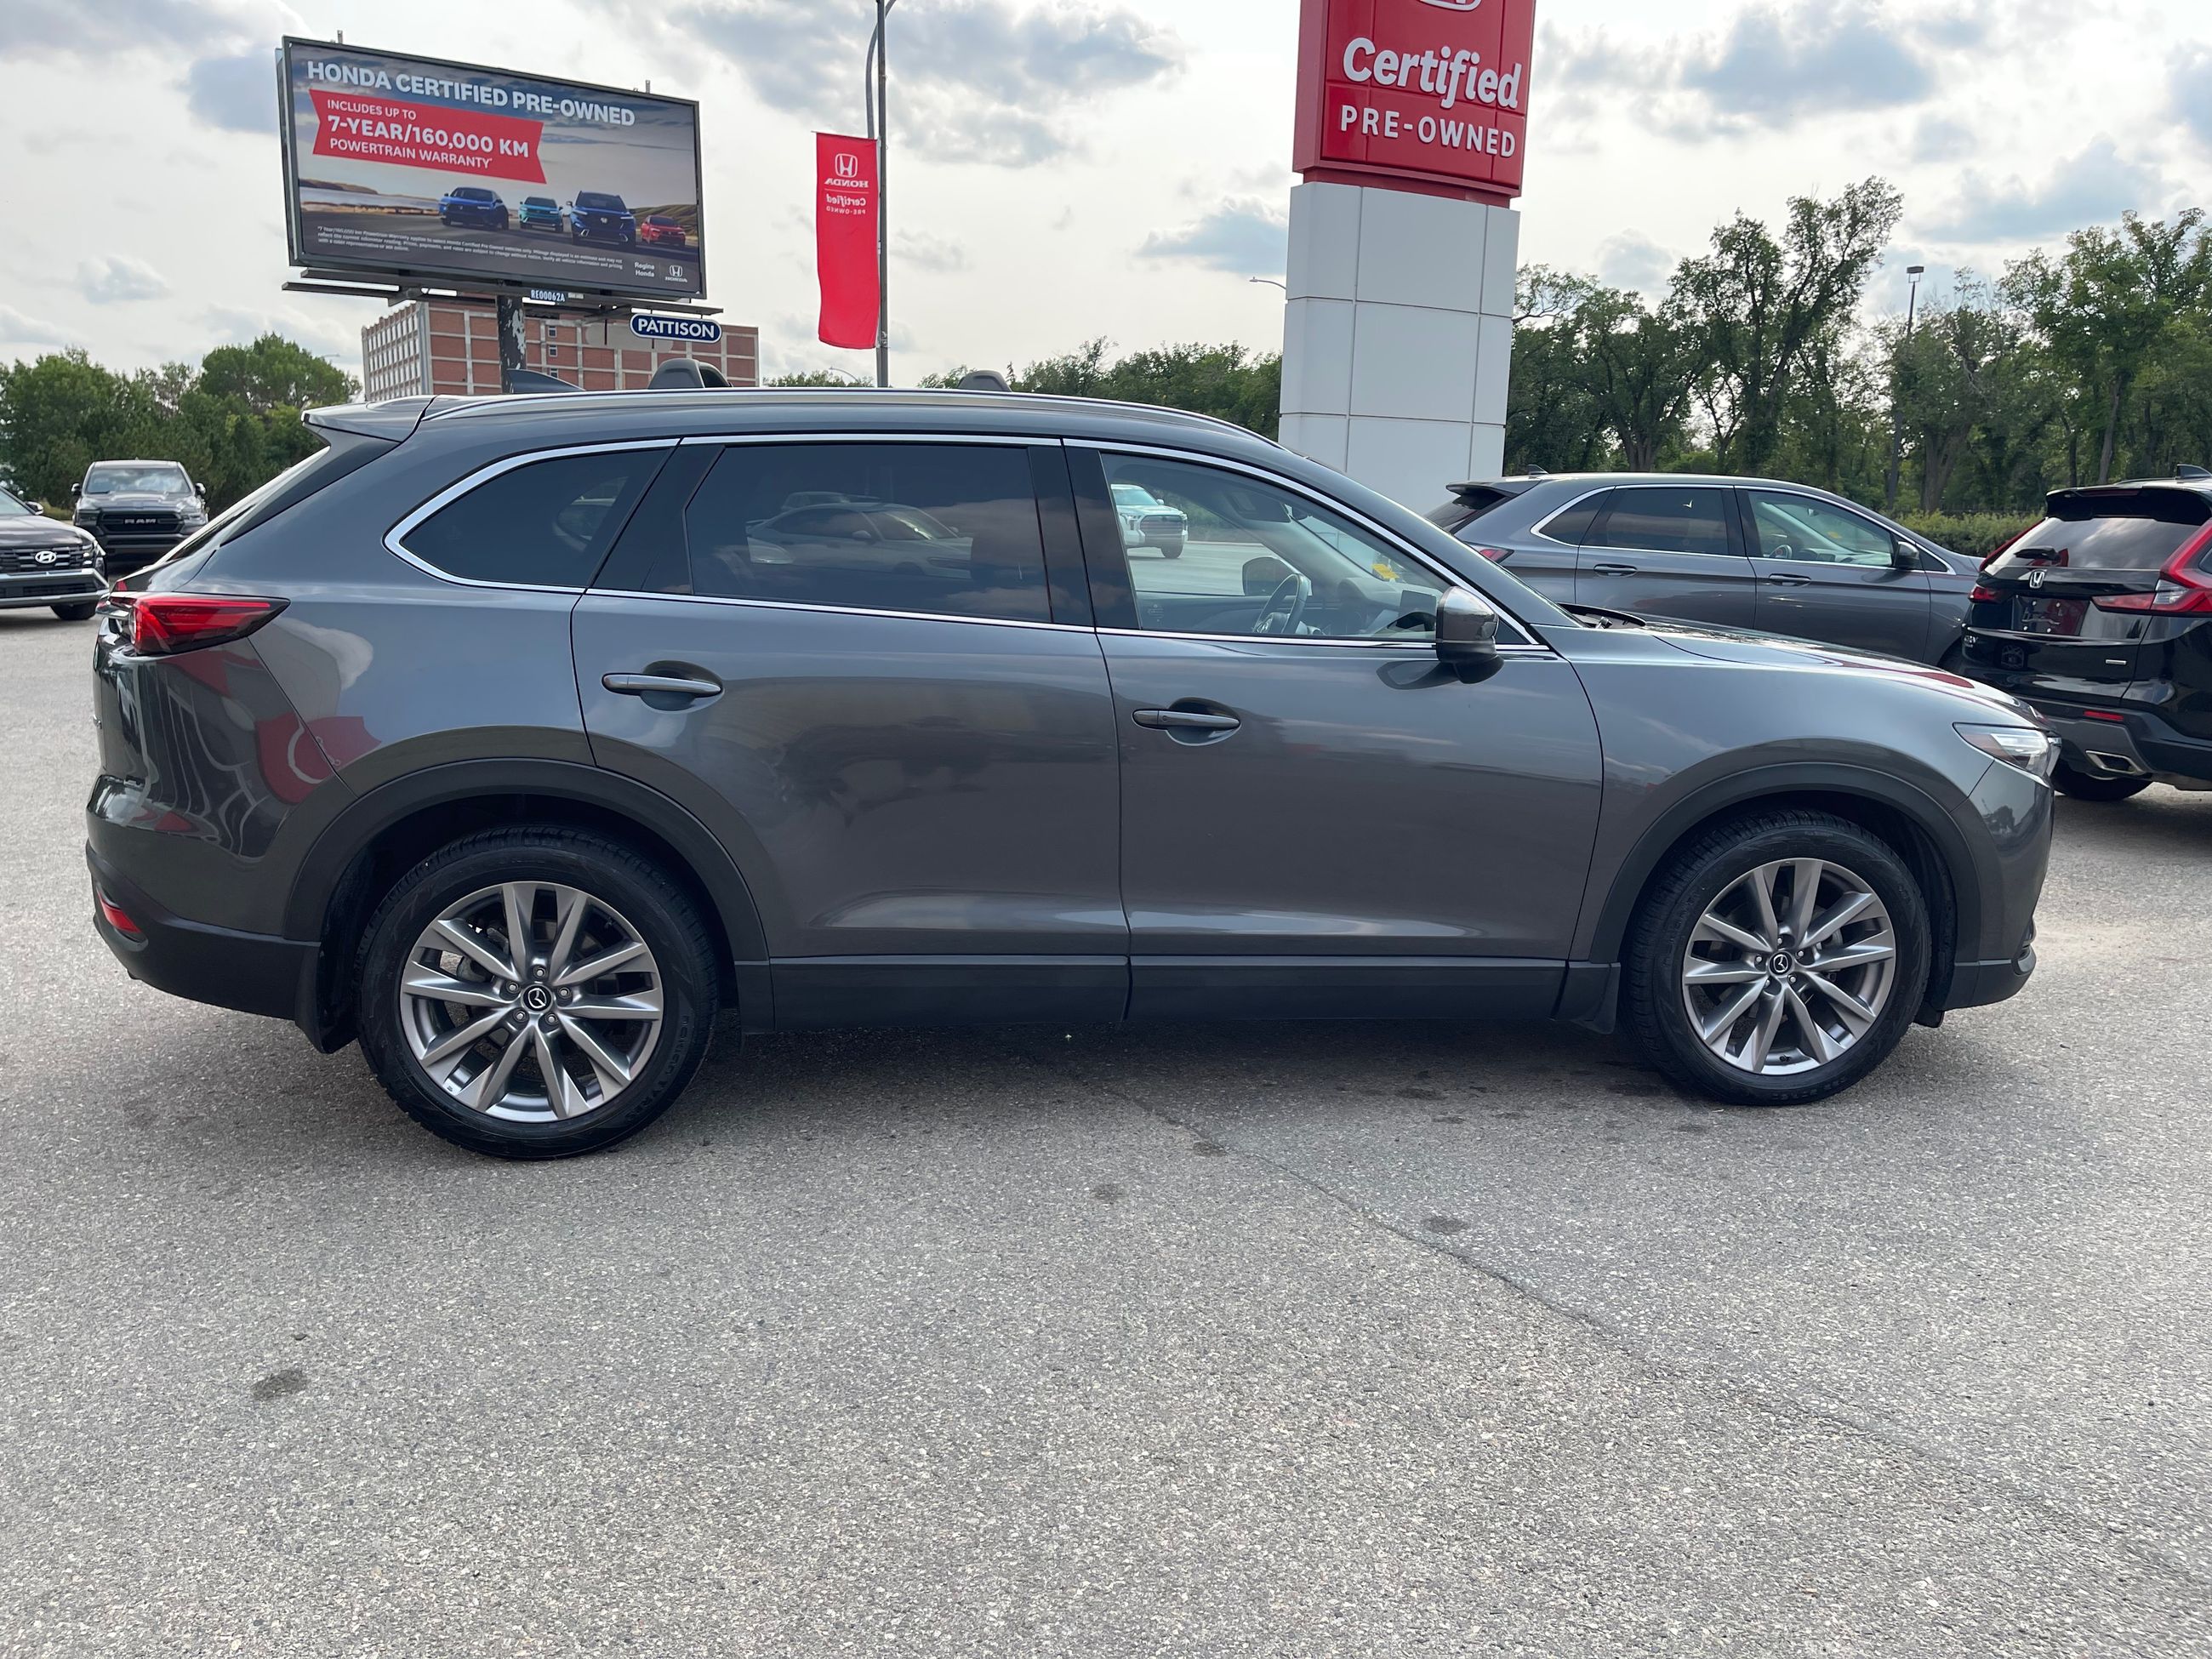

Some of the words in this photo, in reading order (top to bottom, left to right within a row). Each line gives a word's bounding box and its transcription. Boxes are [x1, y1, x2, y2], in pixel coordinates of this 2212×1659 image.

[1343, 37, 1522, 109] Certified
[307, 60, 391, 90] HONDA
[396, 74, 509, 106] CERTIFIED
[512, 90, 636, 126] PRE-OWNED
[327, 99, 383, 116] INCLUDES
[385, 106, 399, 117] UP
[402, 109, 416, 120] TO
[328, 115, 493, 152] 7-YEAR/160,000
[499, 138, 529, 157] KM
[1341, 105, 1515, 157] PRE-OWNED
[330, 138, 416, 159] POWERTRAIN
[531, 289, 566, 302] RE00062A
[638, 318, 715, 339] PATTISON
